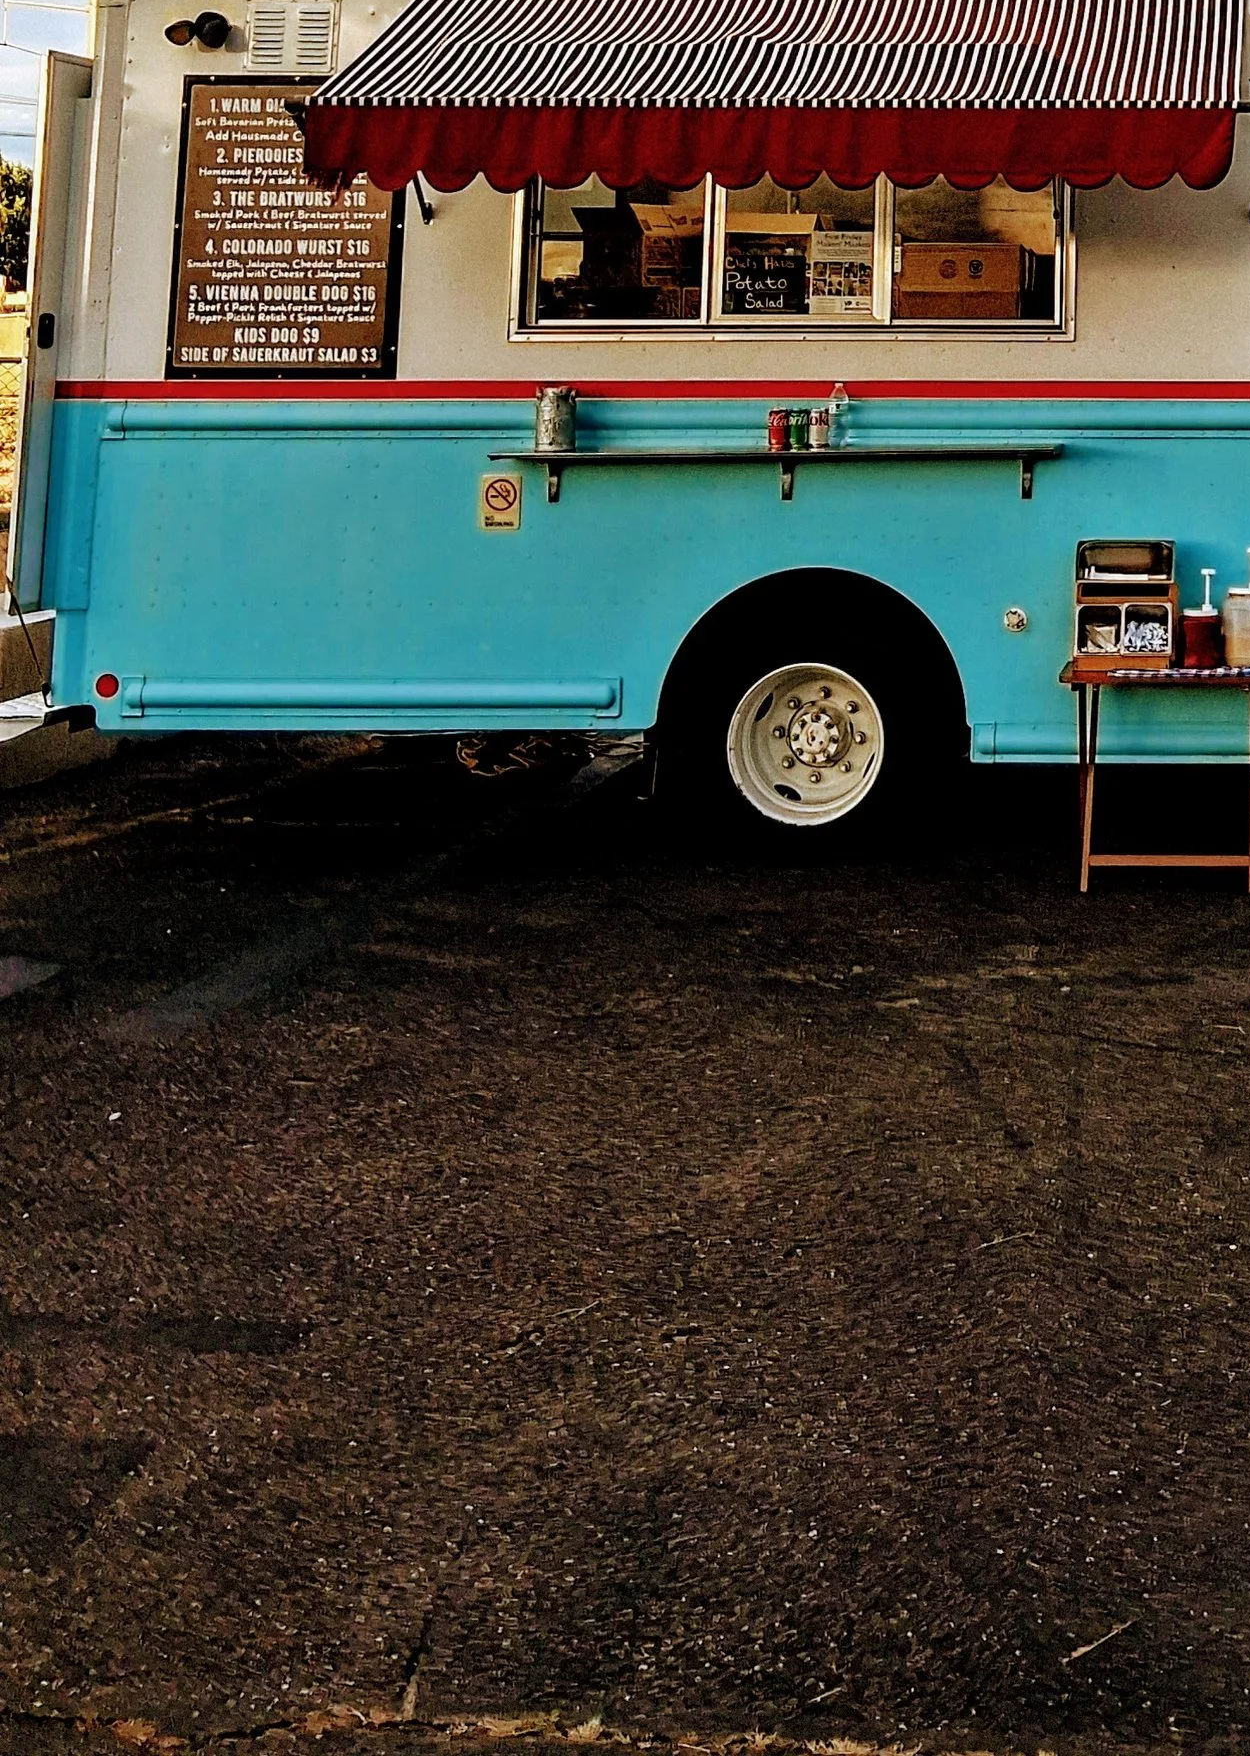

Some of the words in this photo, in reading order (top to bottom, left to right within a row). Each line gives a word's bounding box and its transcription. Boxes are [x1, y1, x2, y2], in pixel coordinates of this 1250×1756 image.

[210, 98, 219, 113] 1.
[221, 98, 262, 113] WARM
[195, 116, 216, 127] Soft
[219, 116, 264, 127] Bavarian
[205, 130, 229, 141] Add
[231, 130, 290, 142] Hausmade
[216, 147, 229, 163] 2.
[233, 147, 304, 164] PIEROGIES
[216, 177, 251, 186] served
[252, 174, 266, 186] w/
[278, 176, 297, 186] side
[255, 167, 289, 180] Potato
[212, 191, 226, 207] 3.
[229, 191, 256, 207] THE
[343, 190, 368, 207] $16
[194, 209, 233, 220] Smoked
[235, 209, 260, 220] Pork
[270, 210, 295, 220] Beef
[297, 209, 350, 220] Bratwurst
[353, 209, 387, 220] served
[207, 220, 221, 232] w/
[224, 220, 282, 231] Sauerkraut
[293, 220, 341, 232] Signature
[343, 220, 372, 231] Sauce
[204, 238, 218, 256] 4.
[222, 238, 293, 256] COLORADO
[296, 238, 343, 256] WURST
[346, 238, 370, 256] $16
[186, 258, 224, 269] Smoked
[292, 259, 334, 269] Cheddar
[336, 259, 387, 269] Bratwurst
[211, 269, 244, 280] topped
[246, 269, 268, 278] with
[270, 269, 304, 279] Cheese
[726, 271, 788, 292] Potato
[188, 285, 202, 301] 5.
[205, 285, 259, 301] VIENNA
[263, 285, 318, 301] DOUBLE
[321, 285, 349, 301] DOG
[352, 285, 377, 302] $16
[744, 292, 785, 310] Salad
[188, 303, 196, 312] 2
[197, 302, 221, 312] Beef
[231, 302, 256, 312] Pork
[258, 302, 324, 313] Frankfurters
[327, 302, 360, 314] topped
[362, 302, 377, 314] w/
[257, 313, 287, 323] Relish
[297, 313, 344, 324] Signature
[347, 313, 376, 323] Sauce
[233, 327, 267, 344] KIDS
[270, 328, 298, 344] DOG
[302, 327, 320, 345] $9
[180, 347, 209, 363] SIDE
[212, 348, 229, 362] OF
[232, 348, 314, 363] SAUERKRAUT
[317, 348, 358, 363] SALAD
[360, 347, 377, 363] $3
